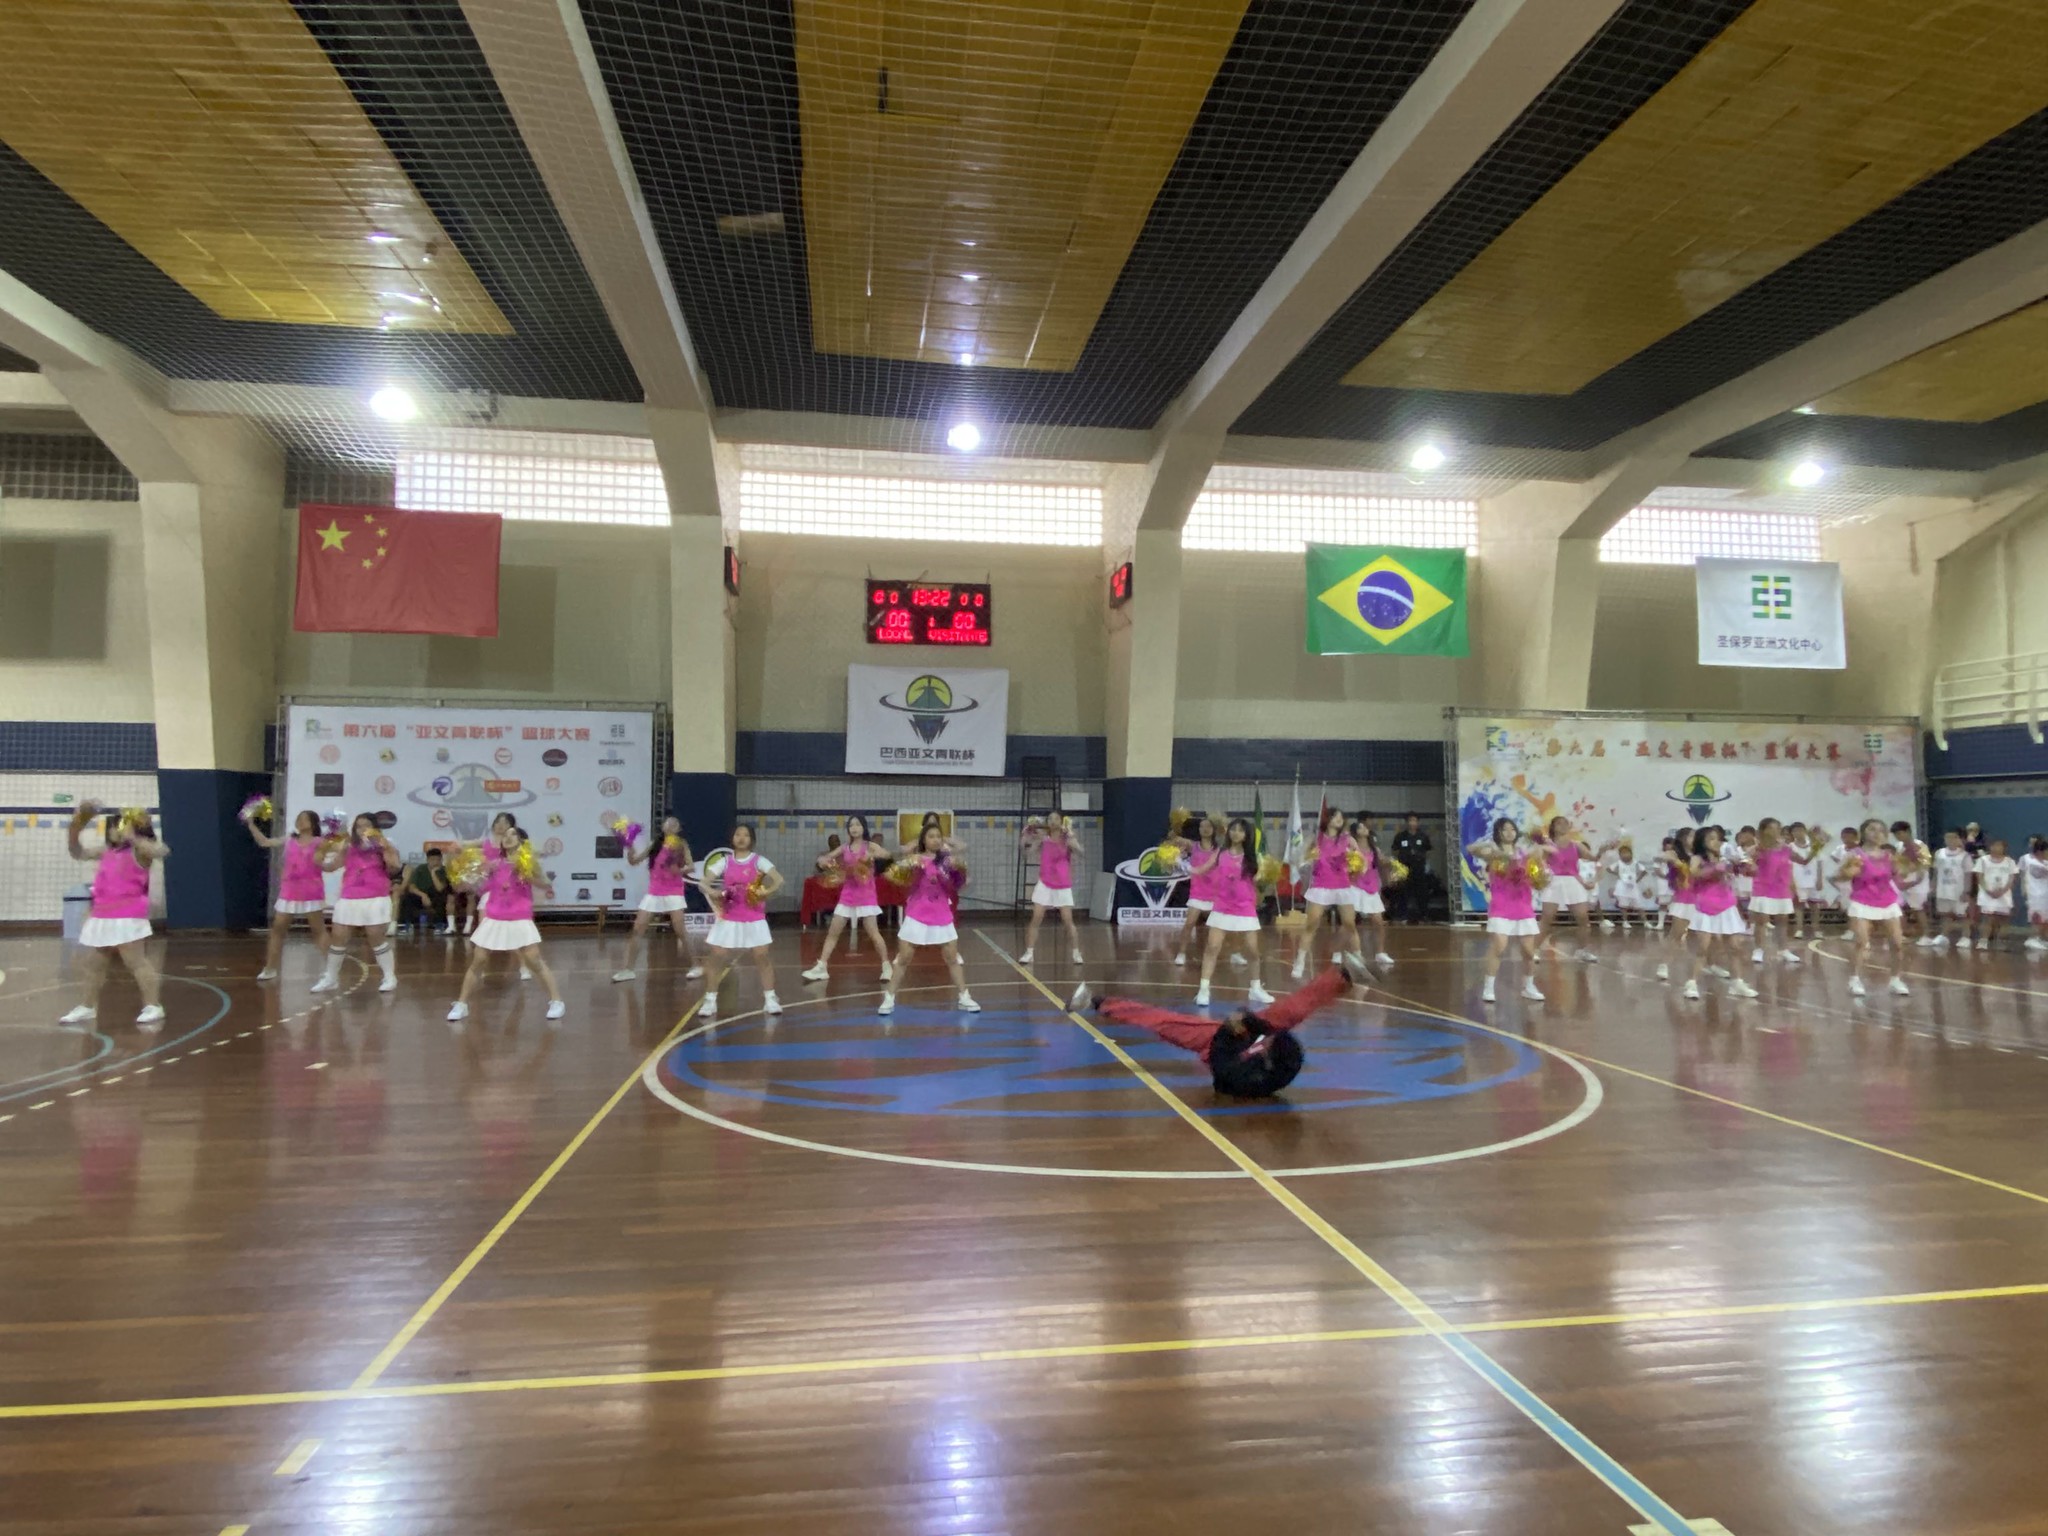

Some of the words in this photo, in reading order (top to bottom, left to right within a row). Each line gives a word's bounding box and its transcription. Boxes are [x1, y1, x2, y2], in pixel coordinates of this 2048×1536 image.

[1717, 635, 1824, 651] 圣保罗亚洲文化中心
[880, 746, 976, 761] 巴西亚文青联杯
